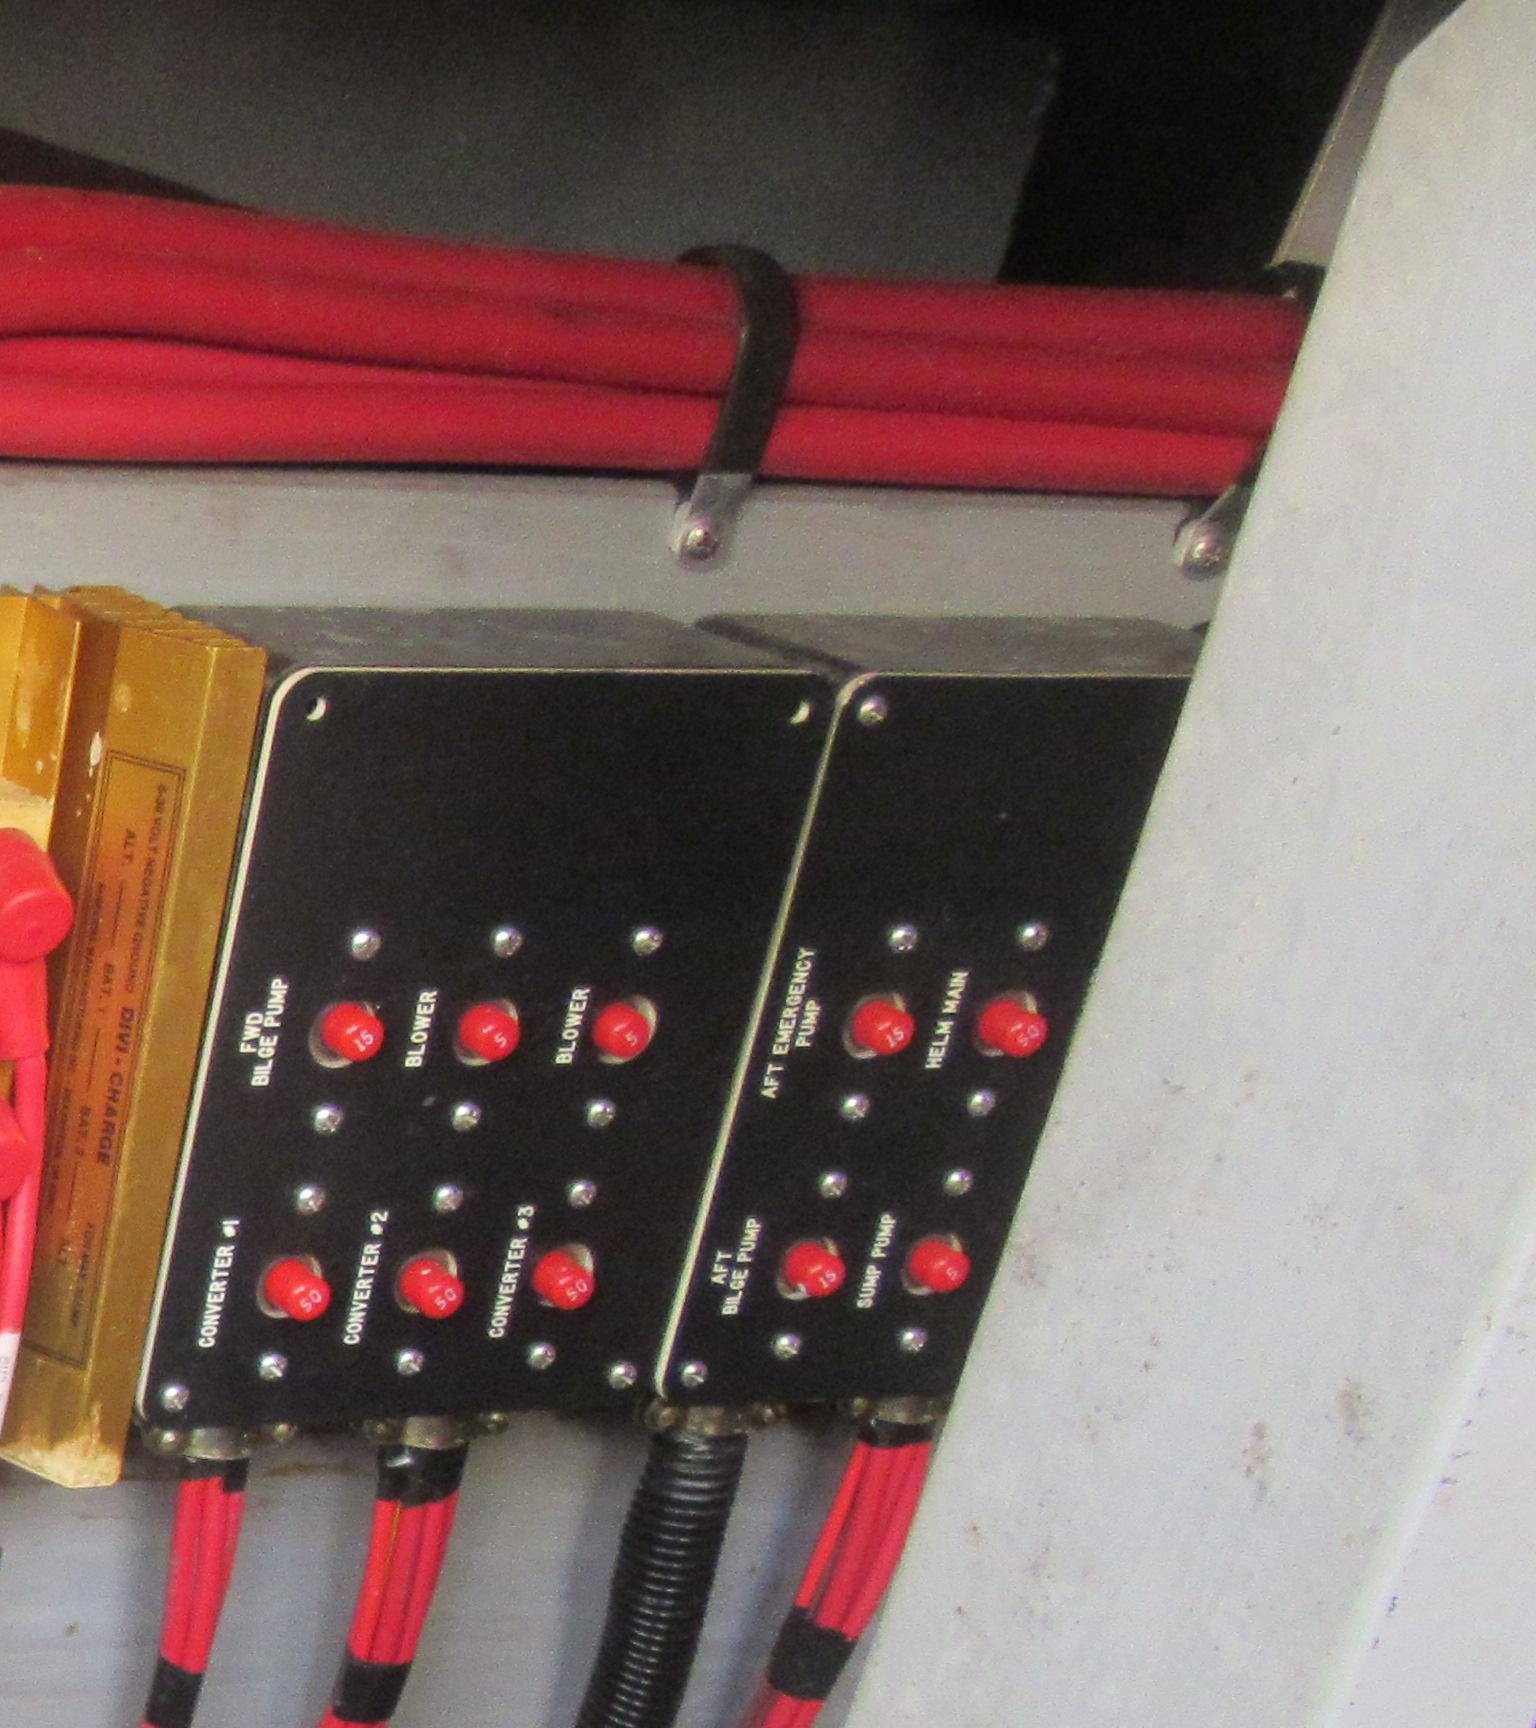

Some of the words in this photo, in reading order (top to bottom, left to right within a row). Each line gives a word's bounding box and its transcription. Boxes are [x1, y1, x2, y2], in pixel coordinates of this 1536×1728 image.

[147, 816, 162, 853] VOLT
[135, 856, 155, 928] NEGATIVE
[263, 977, 290, 1028] PUMP
[555, 985, 591, 1066] BLOWER
[772, 947, 817, 1055] EMERGENCY
[795, 999, 823, 1048] PUMP
[924, 1019, 955, 1070] HELM
[942, 970, 971, 1016] MAIN
[115, 1006, 134, 1053] DIVI
[239, 1011, 265, 1056] FWD
[354, 1031, 375, 1054] 15
[404, 987, 439, 1069] BLOWER
[495, 1033, 509, 1049] 5
[625, 1031, 640, 1048] 5
[884, 1027, 906, 1050] 15
[251, 1028, 281, 1088] BILGE
[760, 1063, 785, 1100] AFT
[96, 1071, 123, 1165] CHARGE
[342, 1238, 383, 1346] CONVERTER
[369, 1209, 390, 1237] #2
[487, 1236, 528, 1340] CONVERTER
[516, 1204, 536, 1231] #3
[711, 1250, 733, 1286] AFT
[721, 1266, 751, 1316] BILGE
[736, 1217, 764, 1264] PUMP
[856, 1264, 883, 1310] SUMP
[871, 1213, 897, 1259] PUMP
[198, 1245, 236, 1348] CONVERTER
[298, 1289, 323, 1314] 50
[435, 1287, 458, 1311] 50
